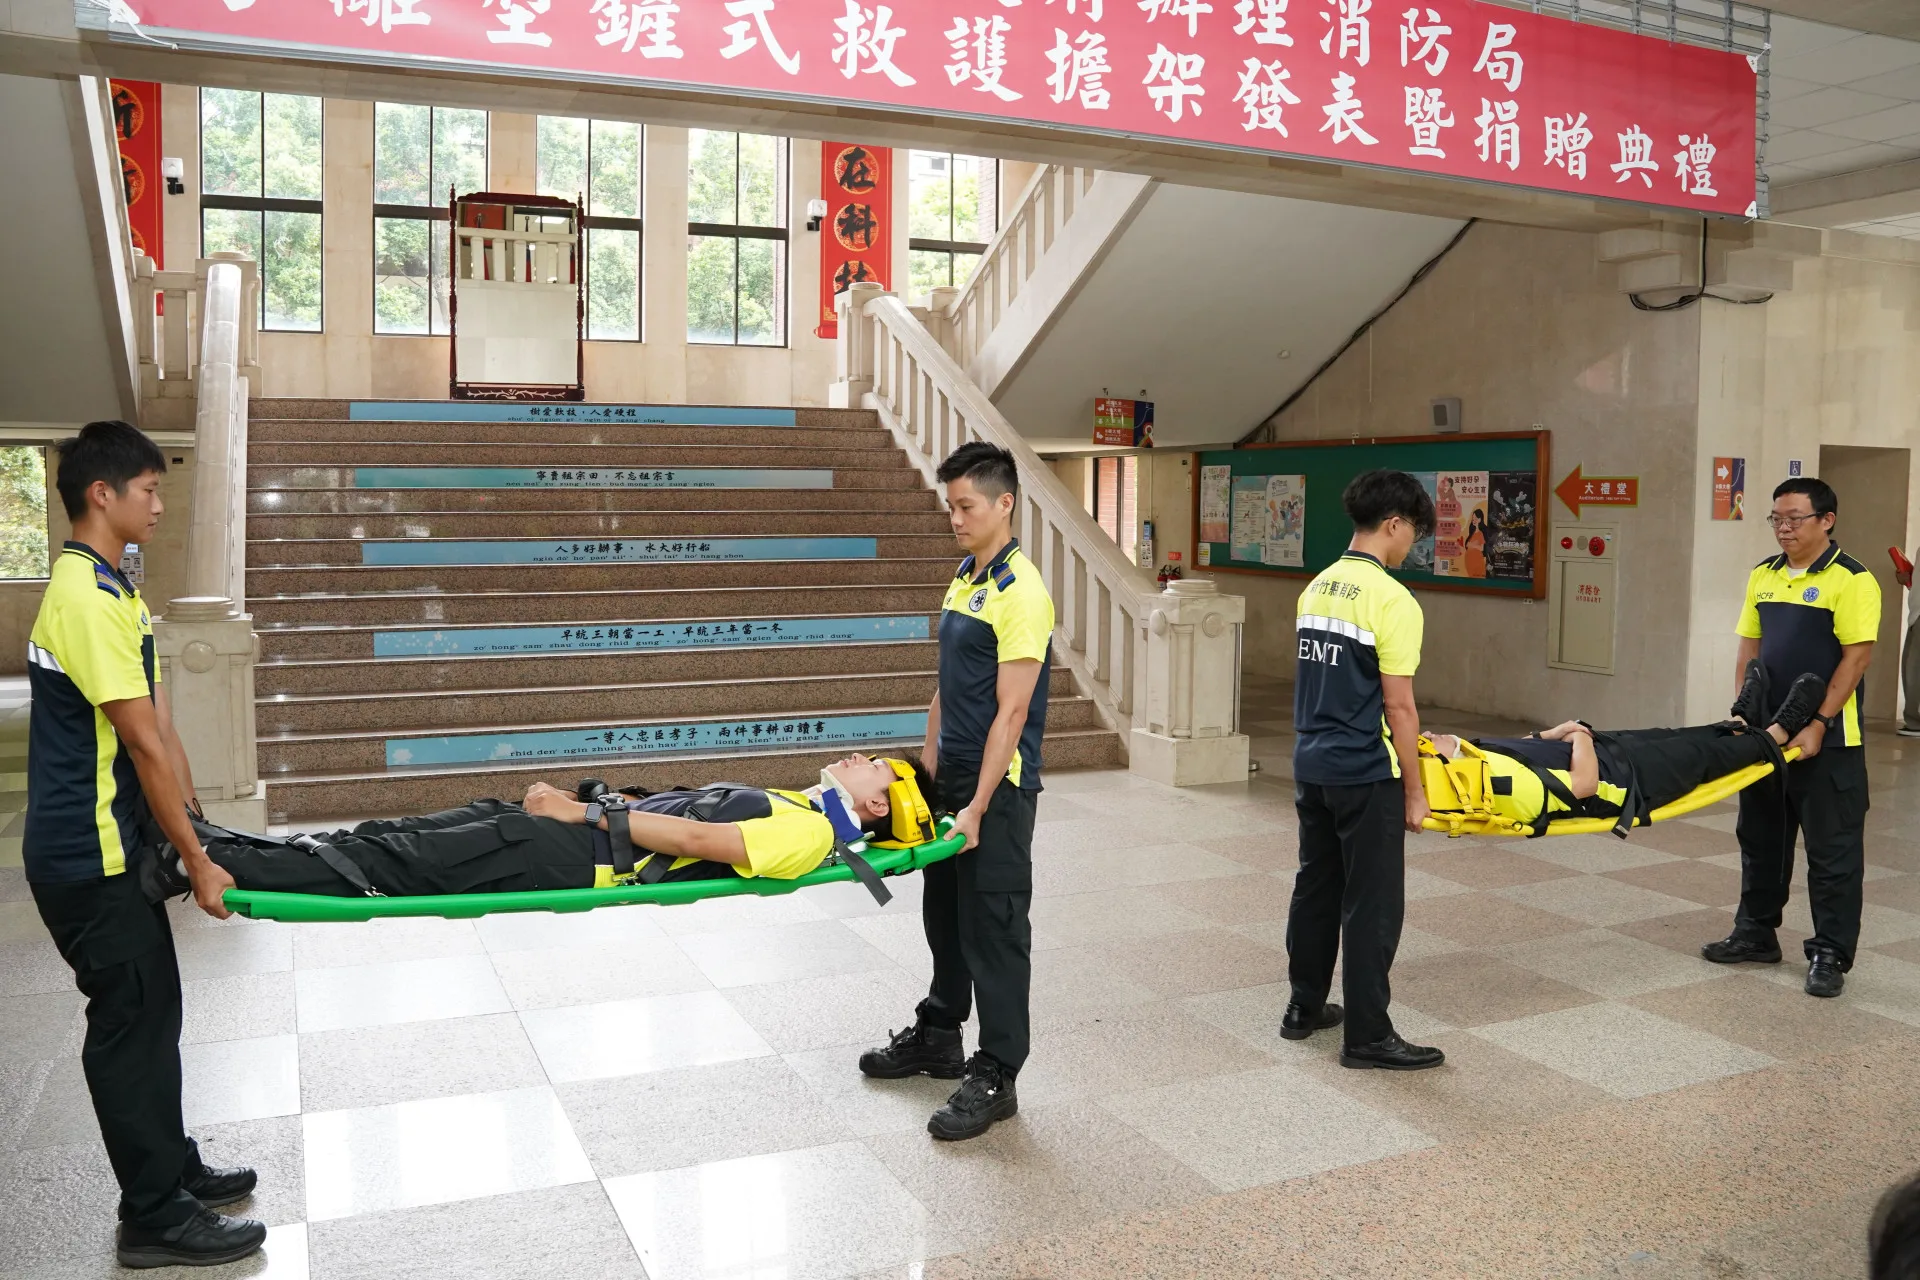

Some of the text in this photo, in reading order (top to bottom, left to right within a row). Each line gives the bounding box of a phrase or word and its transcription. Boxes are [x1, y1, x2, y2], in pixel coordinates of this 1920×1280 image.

[1584, 482, 1627, 495] 大禮堂
[1756, 592, 1774, 600] HCFB
[1297, 638, 1343, 666] EMT
